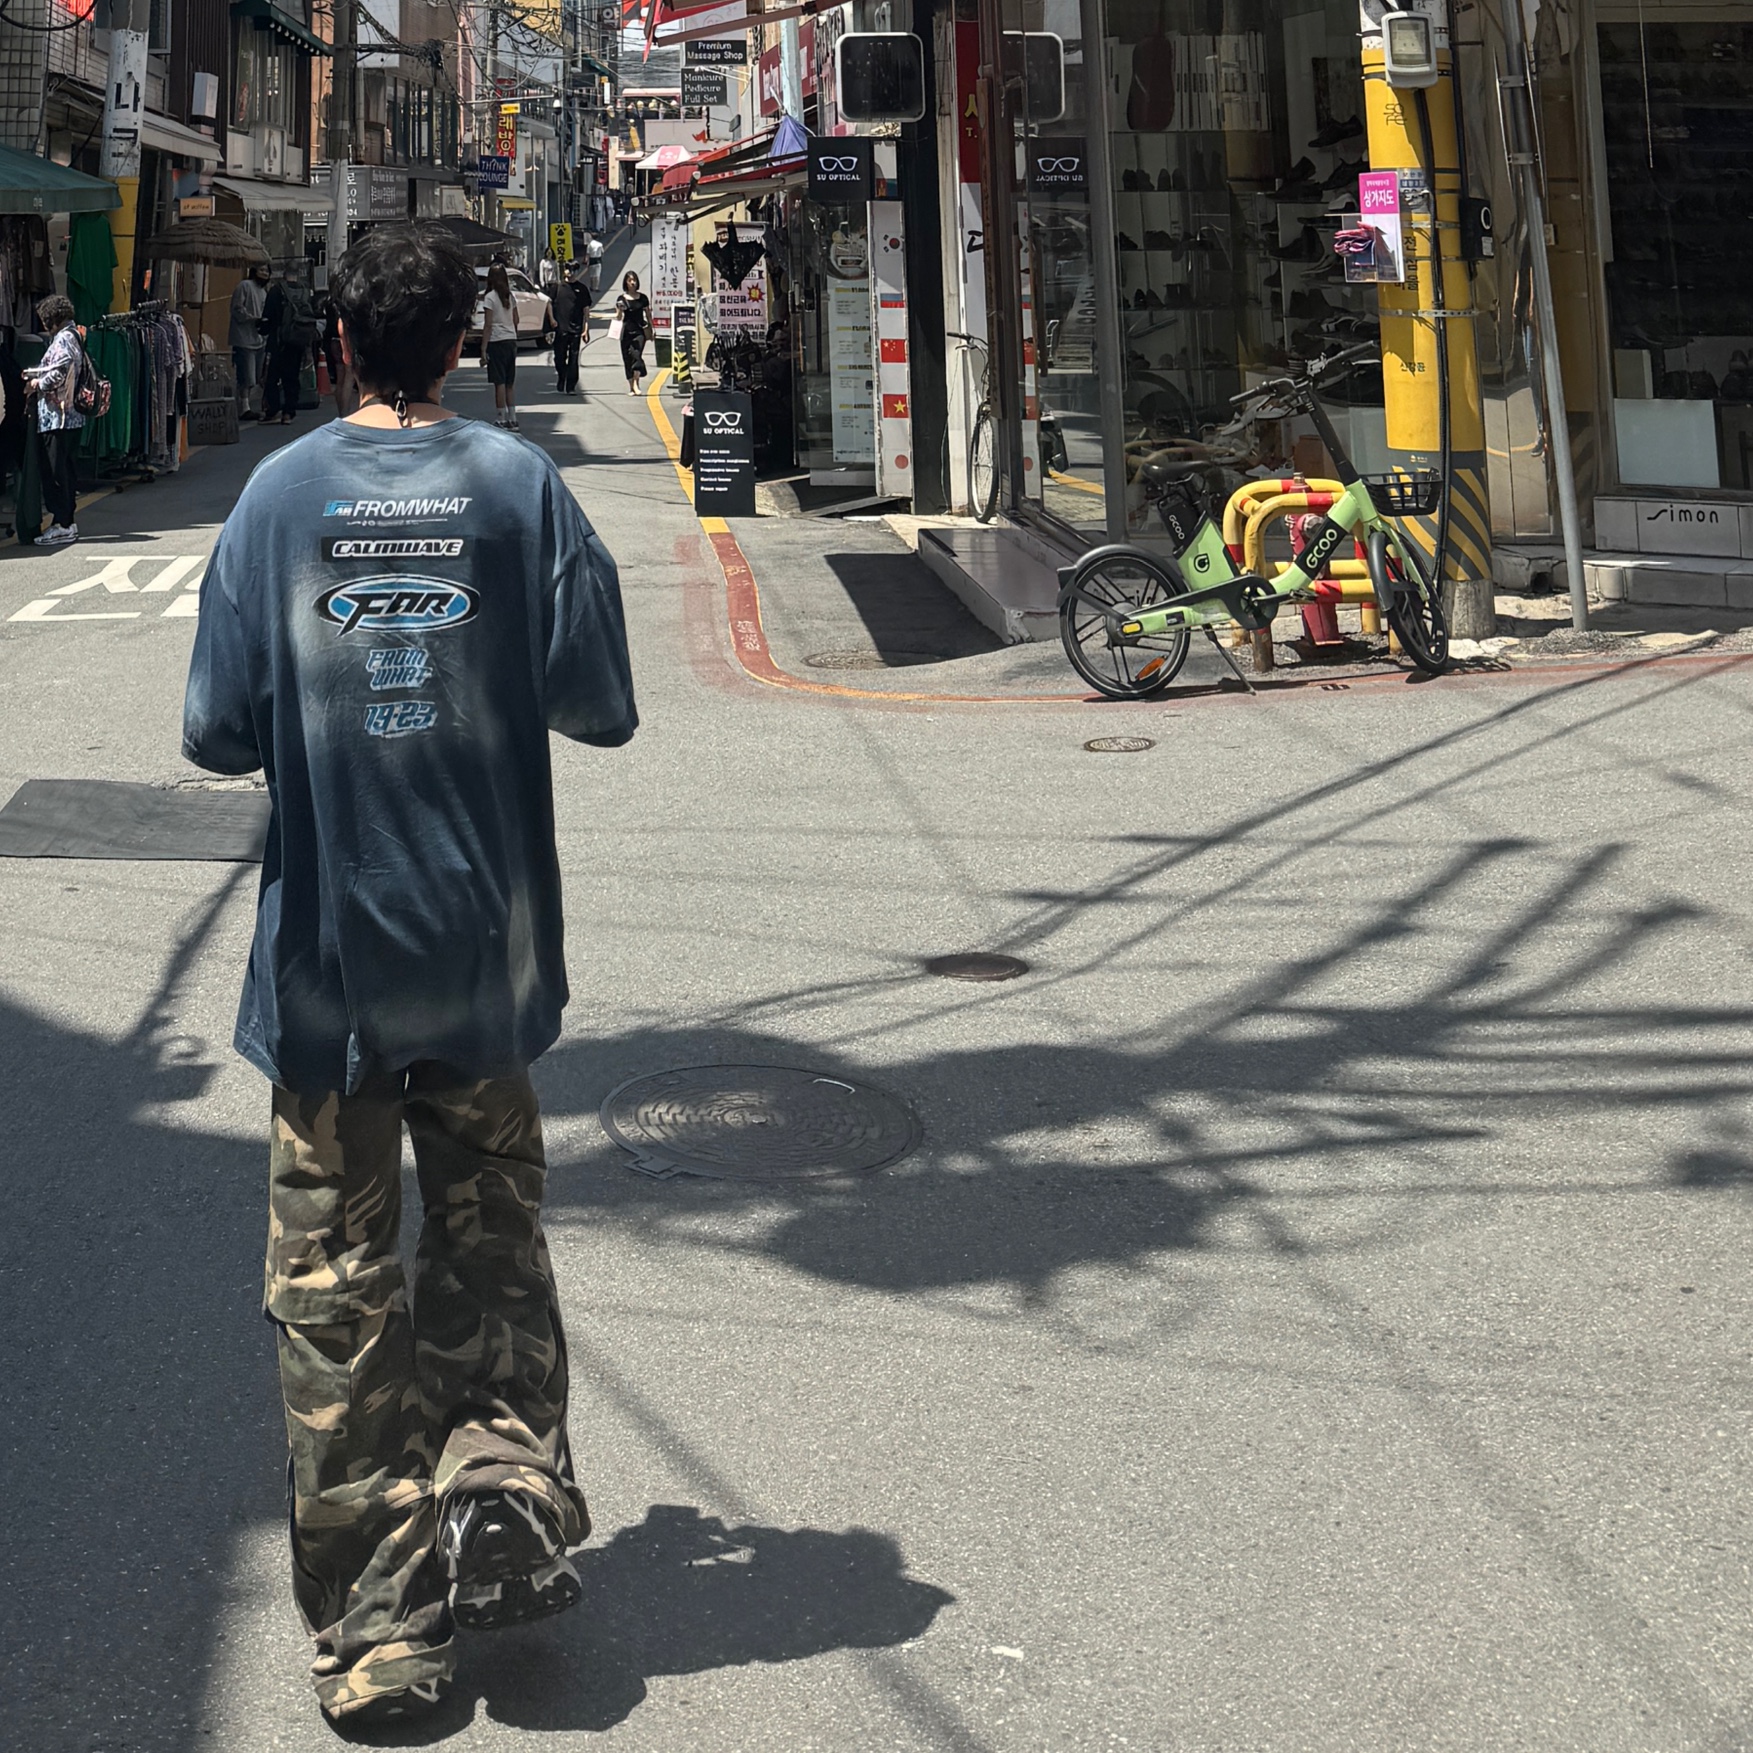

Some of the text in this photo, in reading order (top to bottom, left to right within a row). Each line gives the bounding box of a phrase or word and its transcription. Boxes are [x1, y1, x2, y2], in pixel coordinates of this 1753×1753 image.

[1363, 189, 1395, 208] 상가지도
[353, 497, 473, 518] FROMWHAT
[1168, 514, 1185, 540] GCOO
[332, 539, 464, 557] CALMWAVE
[1306, 528, 1338, 569] GCOO
